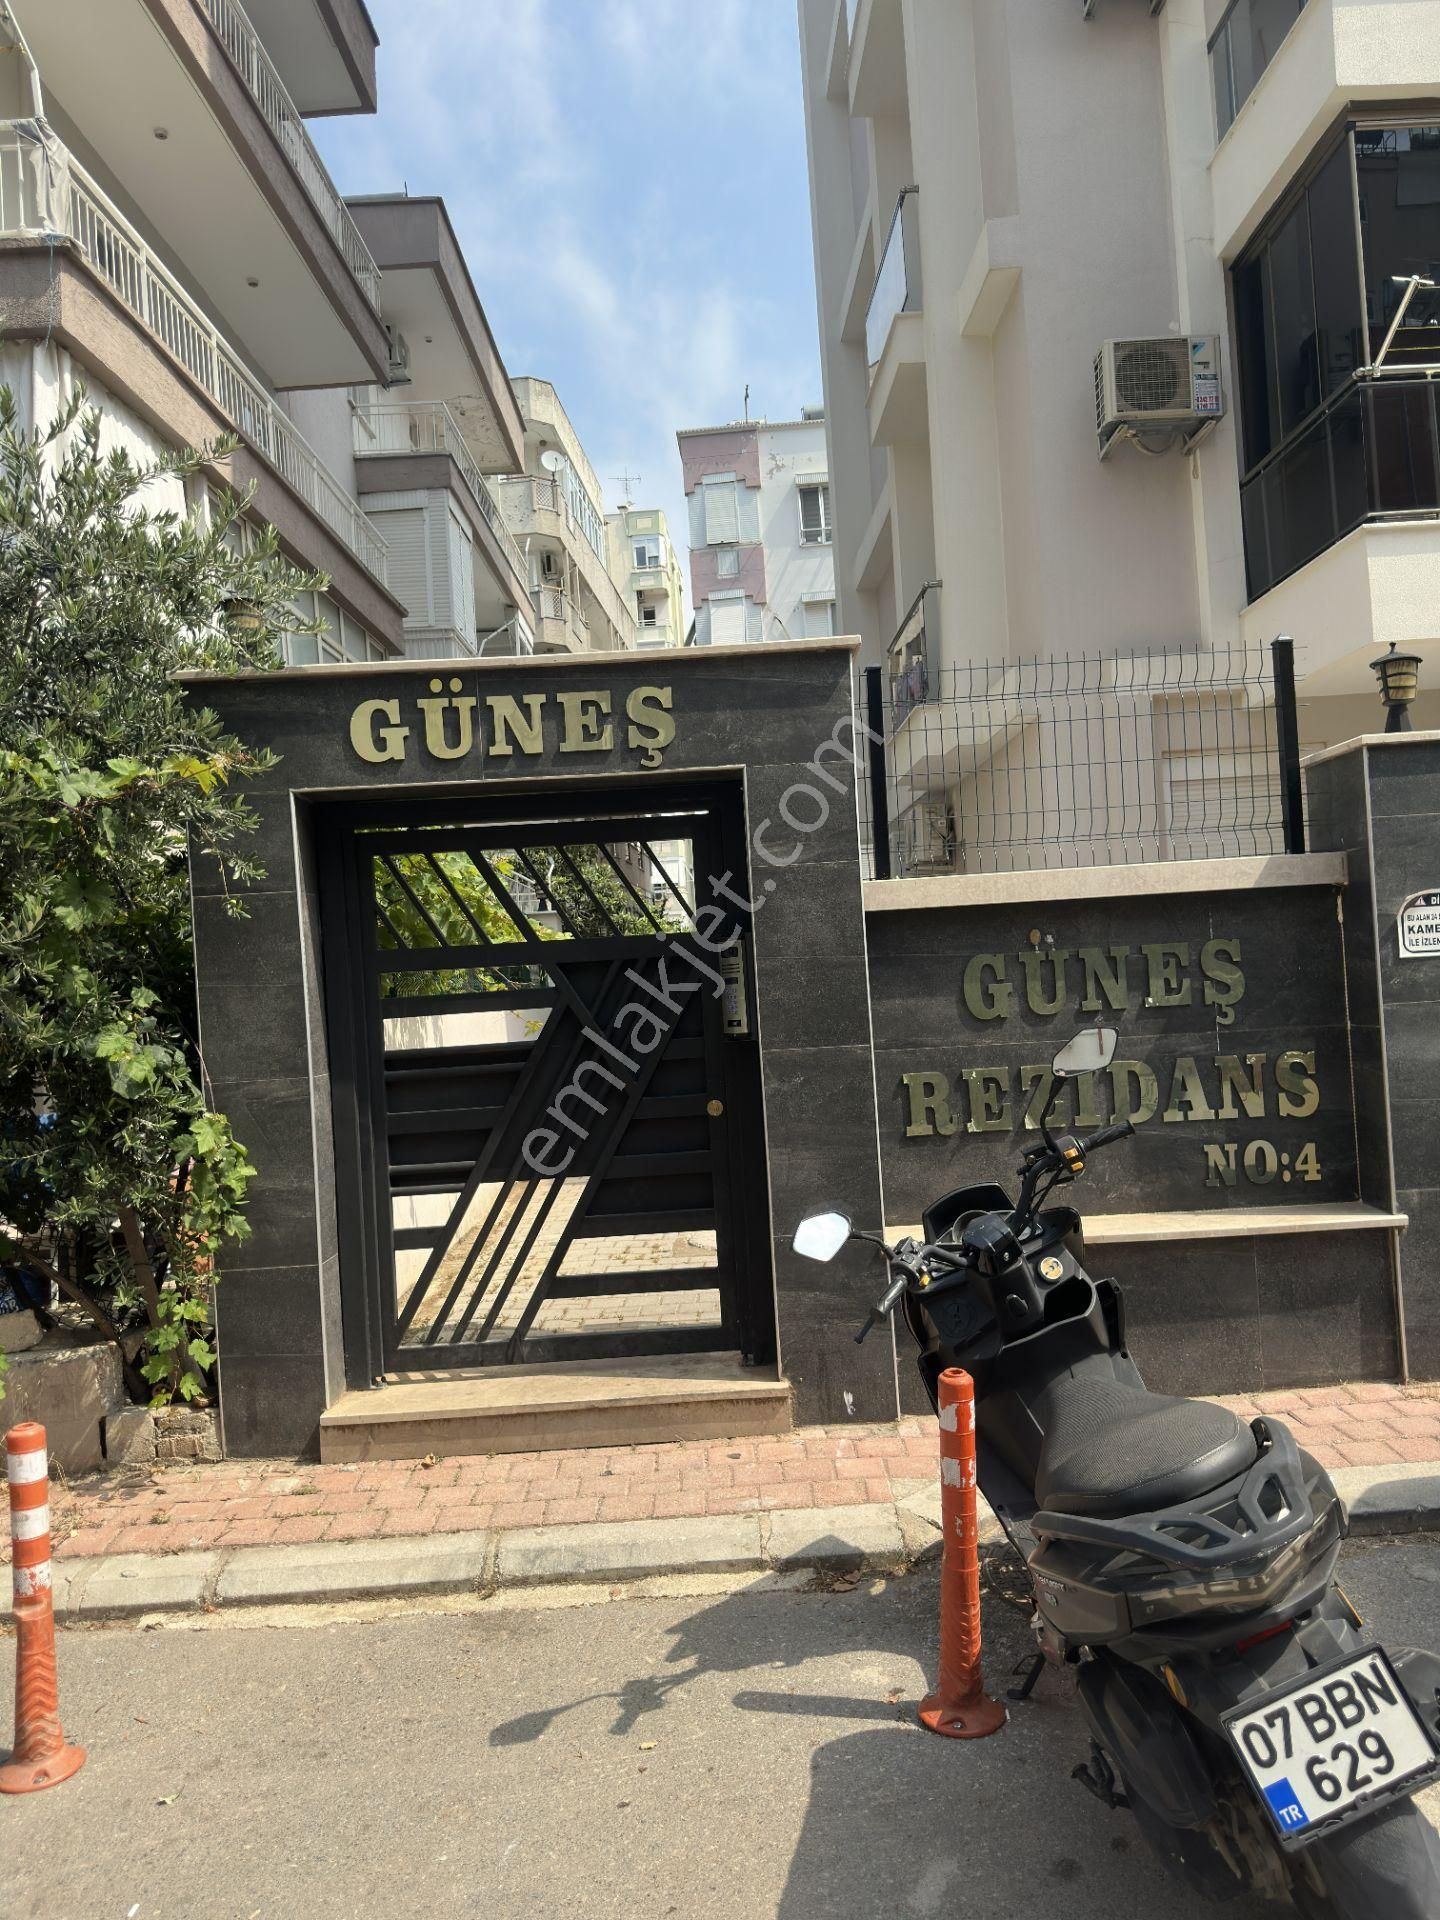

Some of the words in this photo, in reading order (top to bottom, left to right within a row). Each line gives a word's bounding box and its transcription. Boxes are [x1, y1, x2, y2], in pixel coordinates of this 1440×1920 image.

[350, 677, 676, 768] GÜNEŞ
[1408, 914, 1415, 922] BU
[1416, 913, 1431, 921] ALAN
[1408, 936, 1420, 947] İLE
[963, 928, 1246, 1026] GÜNEŞ
[1203, 1139, 1322, 1187] NO:4
[1241, 1705, 1293, 1769] 07
[1294, 1661, 1398, 1744] BBN
[1305, 1729, 1395, 1802] 629
[1278, 1803, 1304, 1825] TR
